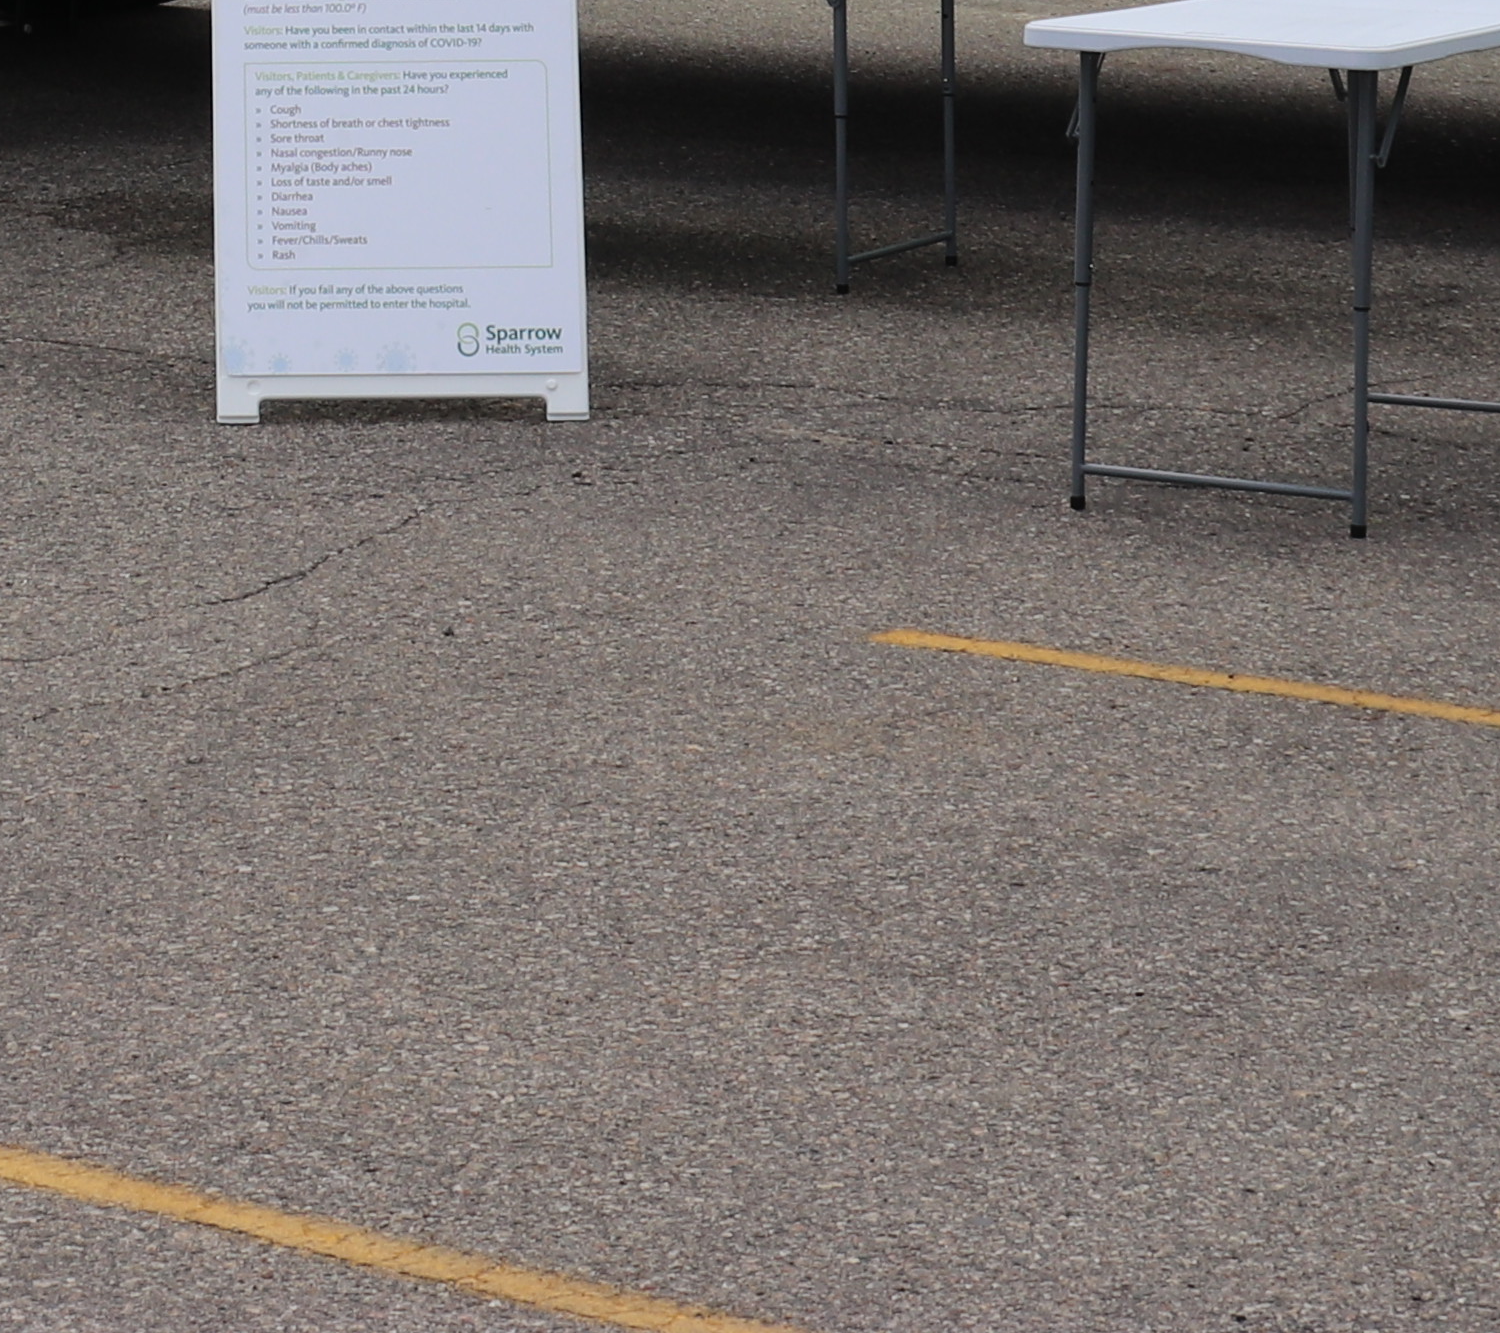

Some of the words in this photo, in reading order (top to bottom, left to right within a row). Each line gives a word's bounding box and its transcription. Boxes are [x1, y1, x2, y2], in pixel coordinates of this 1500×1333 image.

[243, 4, 269, 15] (must
[271, 4, 282, 14] be
[284, 4, 300, 13] less
[302, 4, 323, 13] than
[243, 25, 283, 35] Visitors:
[285, 25, 310, 35] Have
[312, 27, 330, 37] you
[331, 25, 356, 34] been
[357, 25, 366, 34] in
[368, 25, 404, 34] contact
[407, 24, 437, 33] within
[439, 24, 455, 33] the
[457, 24, 473, 33] last
[476, 24, 487, 32] 14
[488, 23, 510, 35] days
[512, 23, 534, 32] with
[244, 41, 287, 50] someone
[290, 39, 311, 49] with
[321, 38, 369, 48] confirmed
[371, 38, 416, 51] diagnosis
[418, 38, 429, 48] of
[430, 38, 482, 48] COVID-19?
[255, 71, 294, 81] Visitors,
[296, 71, 336, 80] Patients
[337, 71, 345, 80] &
[347, 70, 400, 82] Caregivers:
[403, 71, 428, 80] Have
[430, 72, 447, 82] you
[449, 69, 508, 81] experienced
[255, 87, 272, 98] any
[274, 85, 285, 95] of
[287, 86, 302, 95] the
[304, 85, 349, 97] following
[351, 85, 360, 94] in
[363, 85, 378, 94] the
[381, 86, 401, 96] past
[403, 85, 415, 94] 24
[417, 84, 449, 94] hours?
[270, 104, 302, 116] Cough
[270, 119, 317, 129] Shortness
[320, 118, 330, 128] of
[332, 118, 363, 128] breath
[378, 118, 403, 127] chest
[406, 117, 450, 130] tightness
[270, 133, 292, 143] Sore
[294, 133, 324, 143] throat
[271, 148, 298, 158] Nasal
[299, 147, 388, 160] congestion/Runny
[271, 162, 308, 174] Myalgia
[311, 162, 338, 174] (Body
[341, 162, 373, 173] aches)
[271, 177, 292, 187] Loss
[294, 176, 304, 186] of
[307, 177, 331, 186] taste
[332, 176, 364, 187] and/or
[366, 176, 393, 186] smell
[271, 191, 313, 202] Diarrhea
[272, 206, 308, 216] Nausea
[272, 221, 317, 233] Vomiting
[272, 235, 368, 246] Fever/Chills/Sweats
[272, 250, 295, 260] Rash
[247, 285, 287, 295] Visitors:
[289, 284, 297, 294] If
[298, 286, 316, 297] you
[318, 284, 334, 294] fail
[335, 286, 353, 297] any
[354, 284, 365, 294] of
[367, 284, 384, 293] the
[385, 284, 415, 294] above
[416, 284, 464, 296] questions
[247, 302, 265, 313] you
[267, 299, 285, 309] will
[286, 300, 304, 309] not
[305, 299, 317, 309] be
[319, 299, 368, 311] permitted
[370, 300, 381, 309] to
[383, 299, 409, 309] enter
[411, 298, 428, 308] the
[429, 298, 471, 310] hospital.
[485, 325, 562, 344] Sparrow
[485, 344, 521, 354] Health
[524, 344, 563, 356] System
